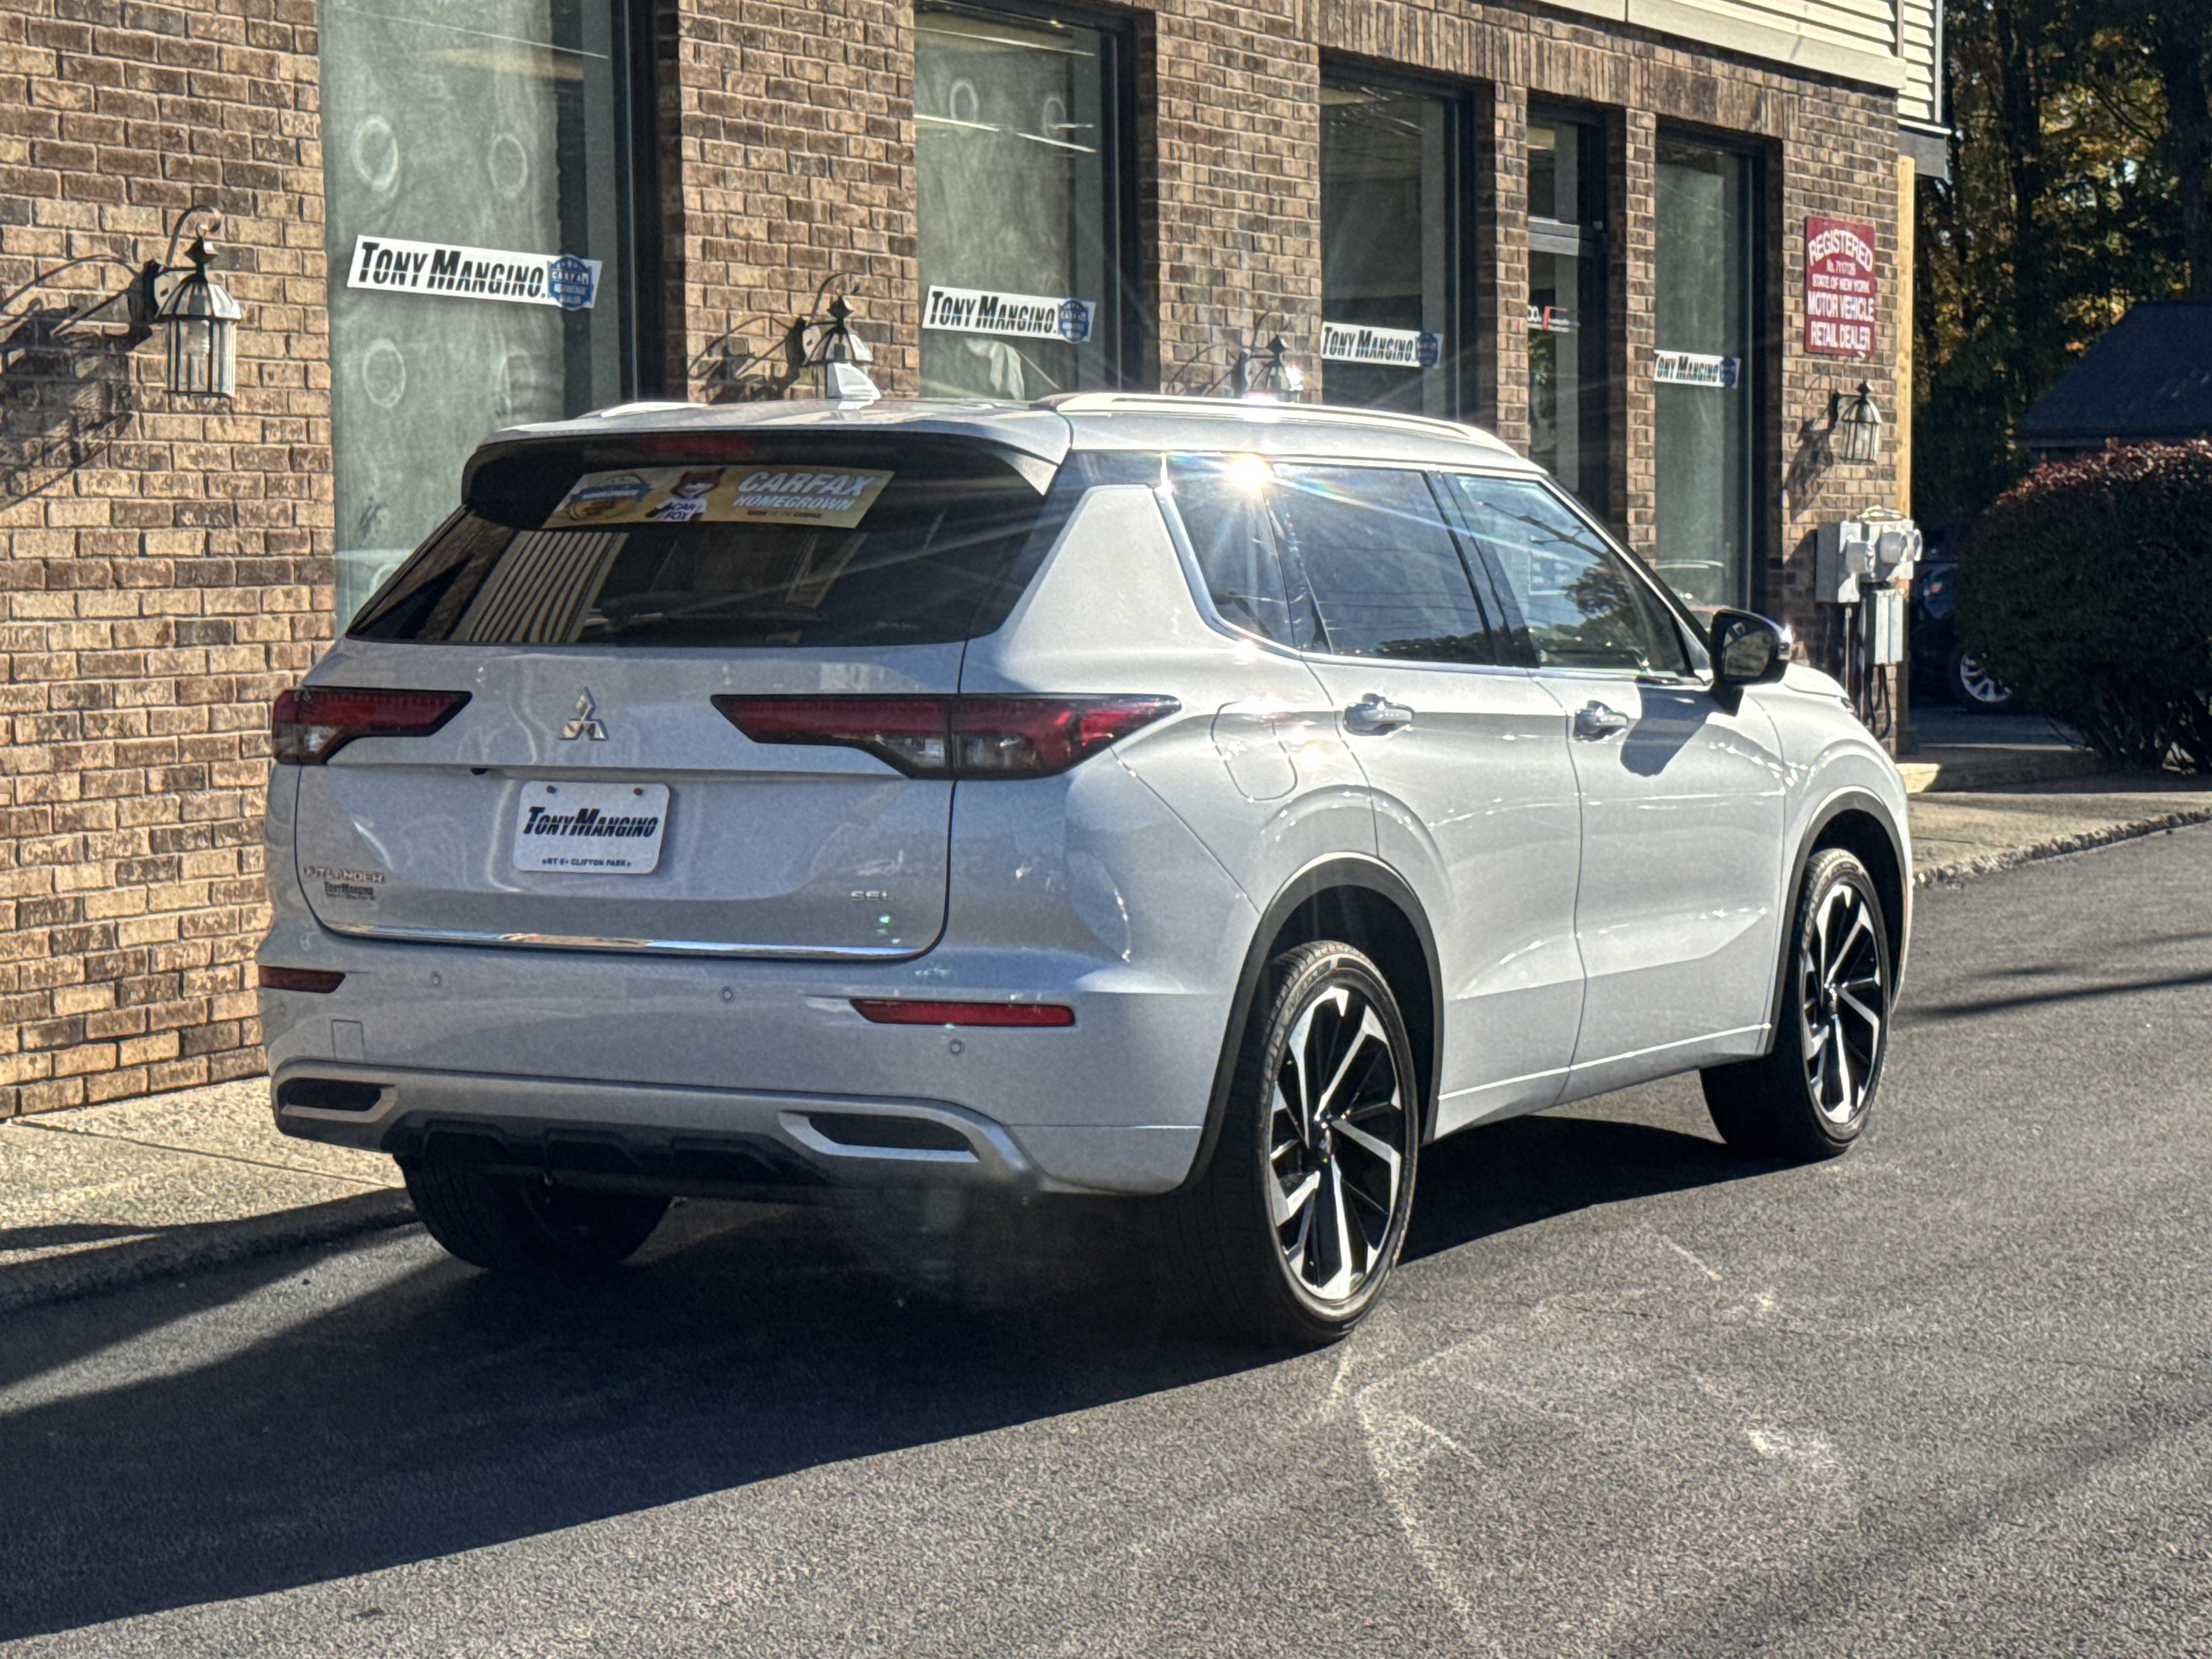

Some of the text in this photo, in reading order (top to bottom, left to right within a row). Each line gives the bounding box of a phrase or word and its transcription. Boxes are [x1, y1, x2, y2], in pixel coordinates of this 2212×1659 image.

[358, 241, 428, 287] TONY
[1808, 228, 1874, 273] REGISTERED
[1830, 275, 1839, 290] OF
[929, 291, 977, 327] TONY
[1808, 290, 1875, 323] MOTOR VEHICLE
[1322, 326, 1356, 357] TONY
[1811, 320, 1870, 351] RETAIL DEALER
[738, 471, 877, 496] CARFAX
[732, 494, 856, 510] HOMEGROWN
